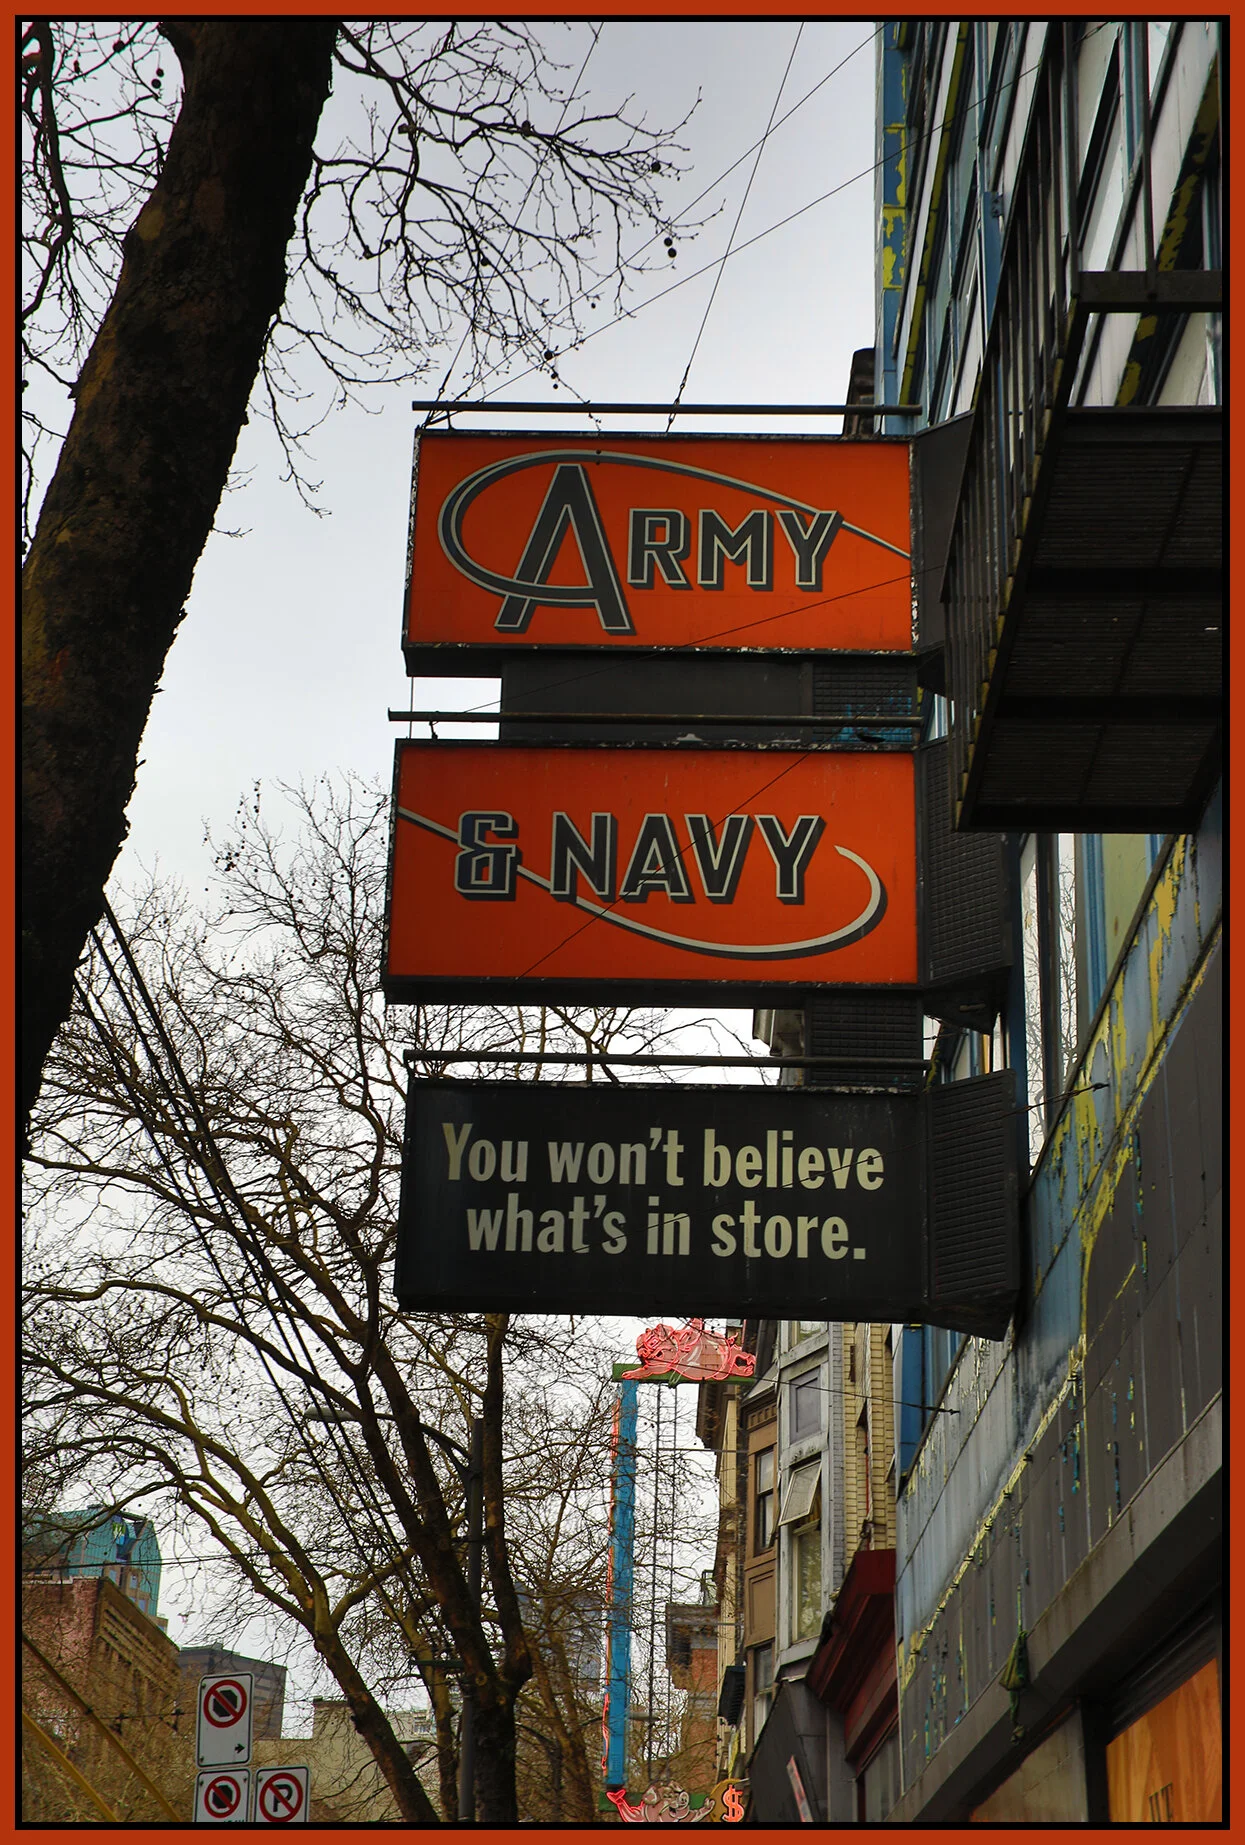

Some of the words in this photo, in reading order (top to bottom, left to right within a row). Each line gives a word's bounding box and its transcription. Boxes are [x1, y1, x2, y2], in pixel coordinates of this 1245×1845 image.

[494, 463, 841, 635] ARMY
[454, 811, 520, 900] &
[549, 811, 827, 905] NAVY
[442, 1122, 528, 1182] You
[548, 1127, 684, 1186] won't
[703, 1128, 884, 1191] believe
[466, 1193, 627, 1254] what's
[646, 1196, 691, 1256] in
[711, 1200, 866, 1260] store.
